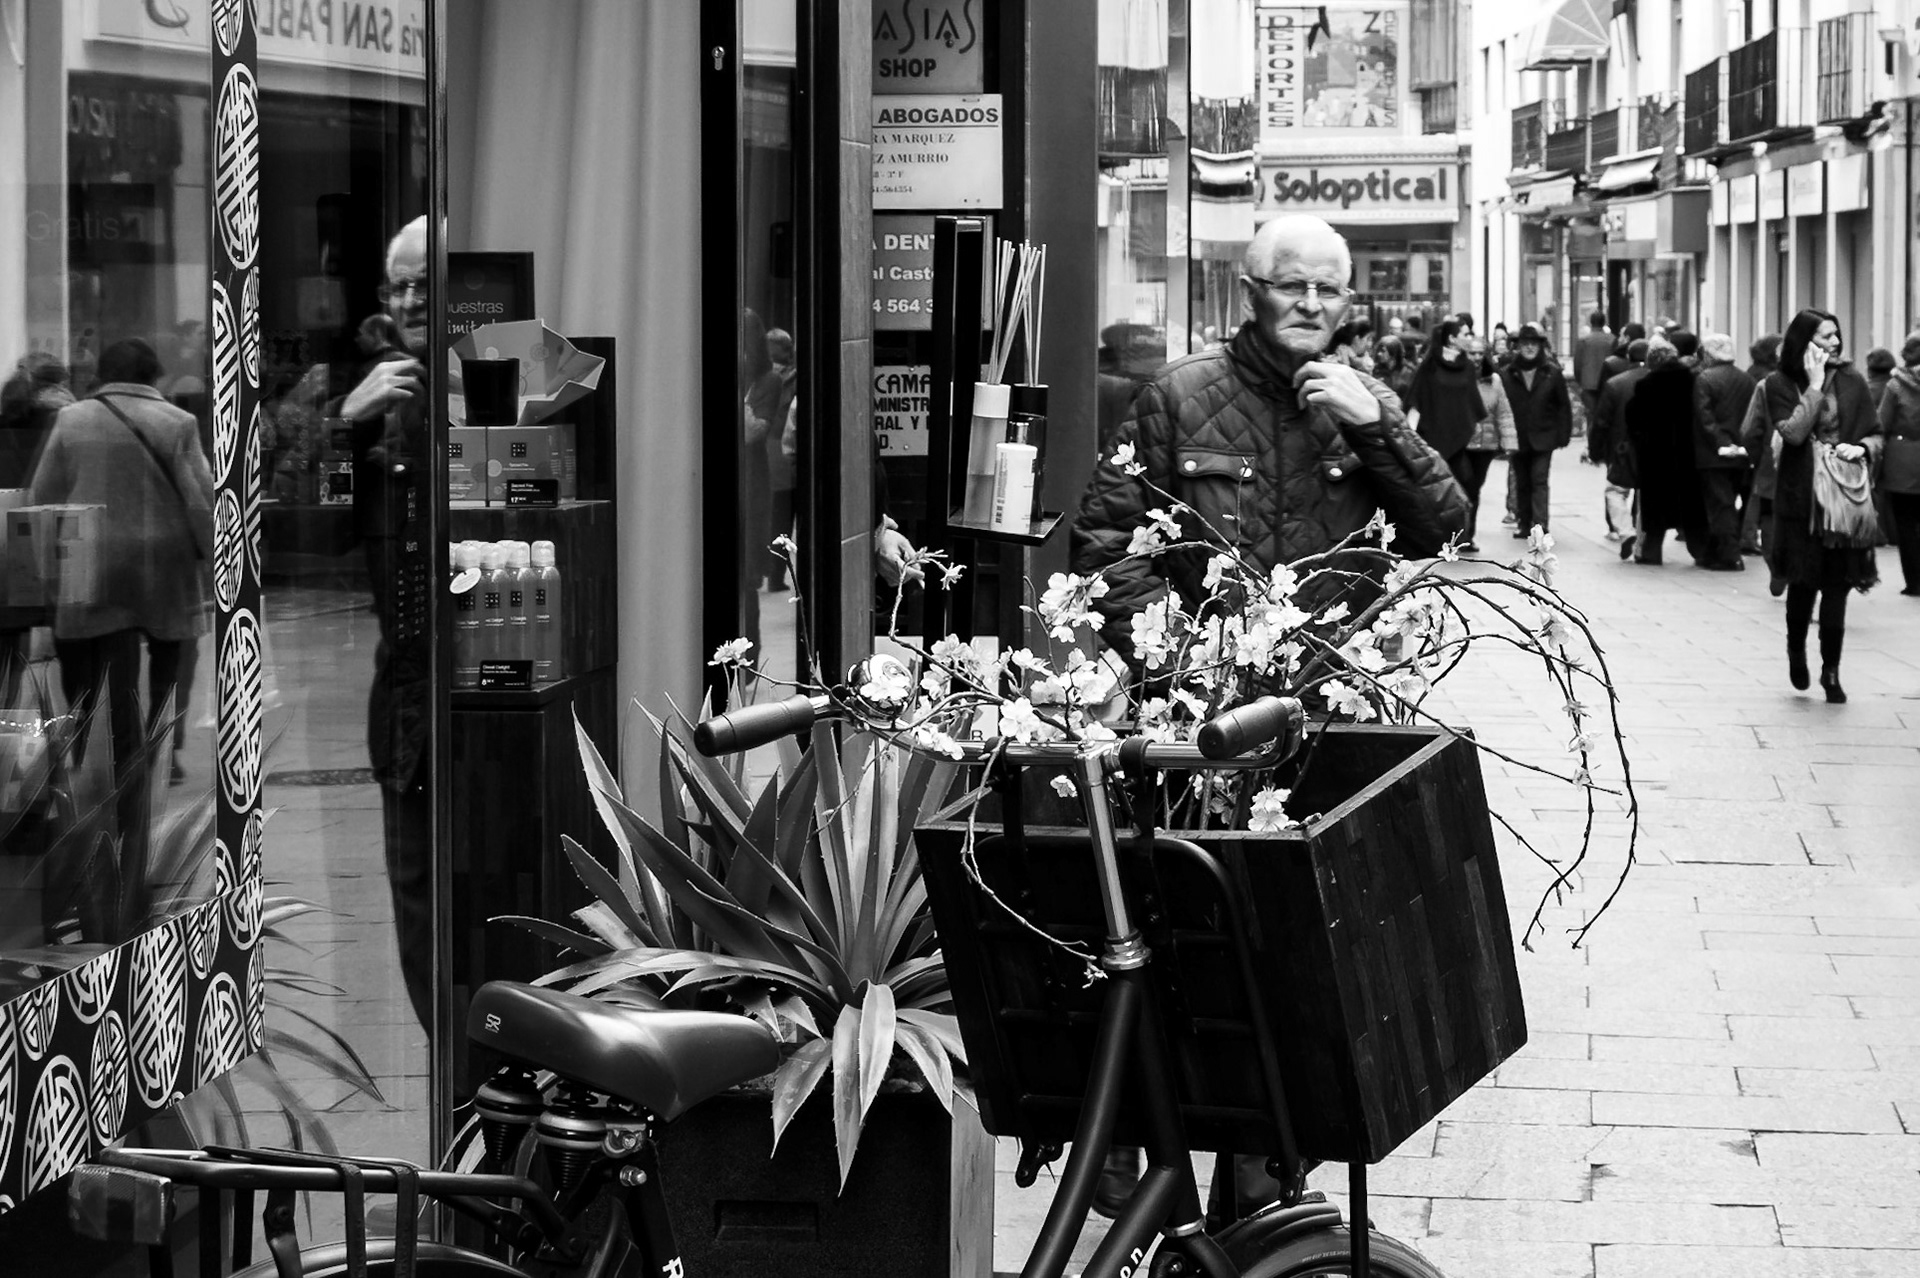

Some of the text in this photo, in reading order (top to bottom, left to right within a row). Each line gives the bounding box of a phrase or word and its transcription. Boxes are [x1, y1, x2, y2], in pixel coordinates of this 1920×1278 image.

[879, 58, 937, 77] SHOP
[1268, 16, 1294, 127] DEPORTES
[878, 107, 999, 124] ABOGADOS
[892, 133, 955, 146] MARQUEZ
[889, 152, 949, 163] AMURRIO
[1273, 168, 1447, 209] Soloptical
[889, 266, 934, 280] Cast
[887, 298, 920, 313] 564
[874, 415, 903, 430] RAL
[910, 415, 919, 430] Y
